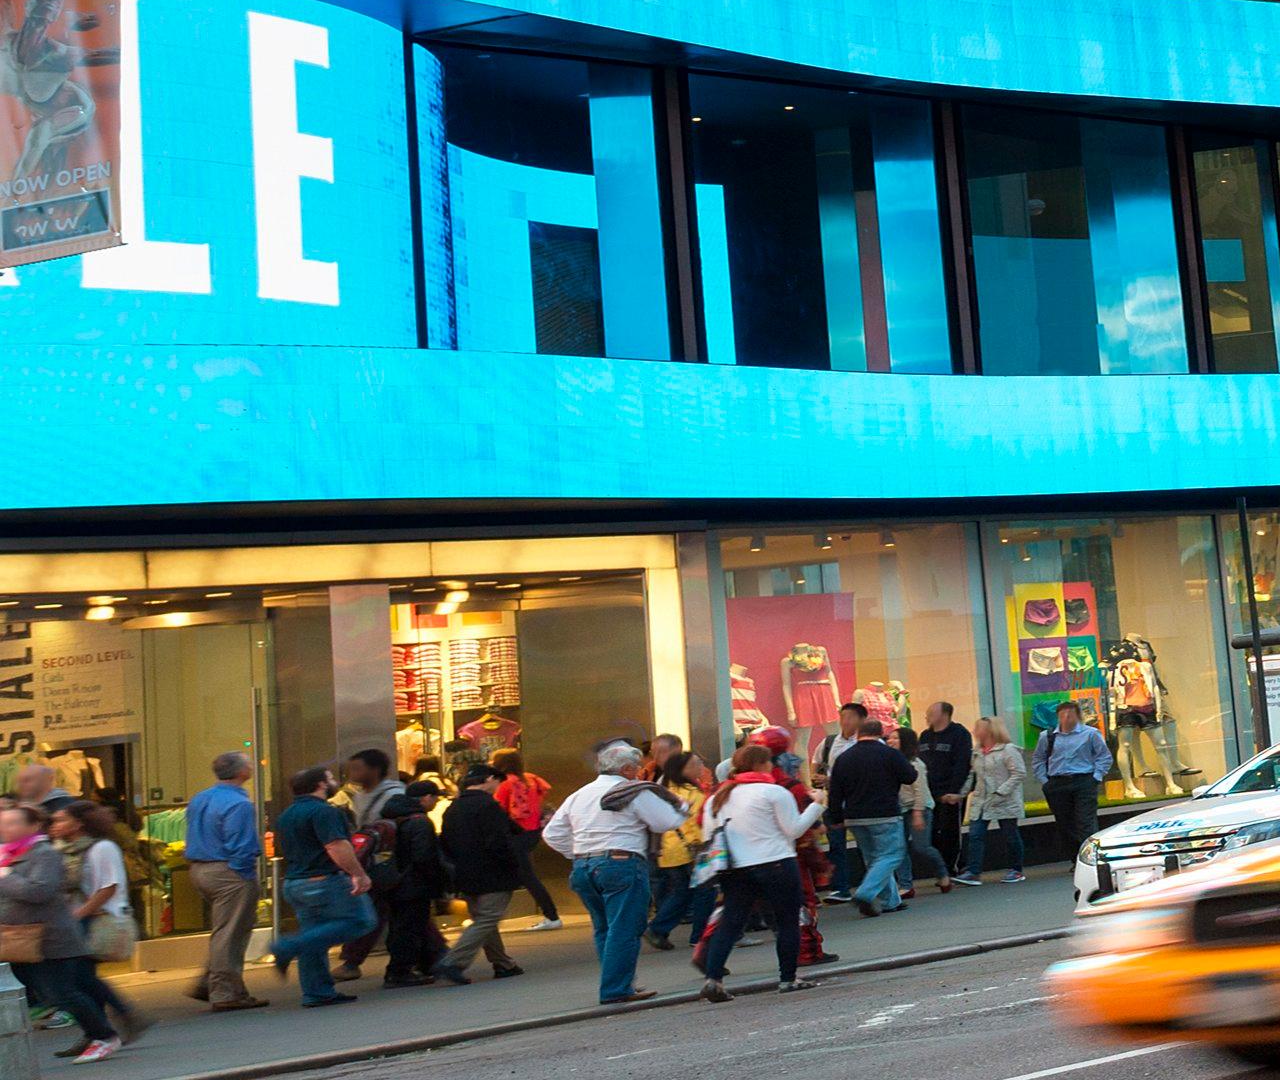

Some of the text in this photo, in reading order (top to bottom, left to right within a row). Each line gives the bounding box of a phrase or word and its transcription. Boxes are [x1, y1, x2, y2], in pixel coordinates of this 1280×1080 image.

[0, 161, 111, 197] NOW OPEN
[42, 650, 135, 669] SECOND LEVEL
